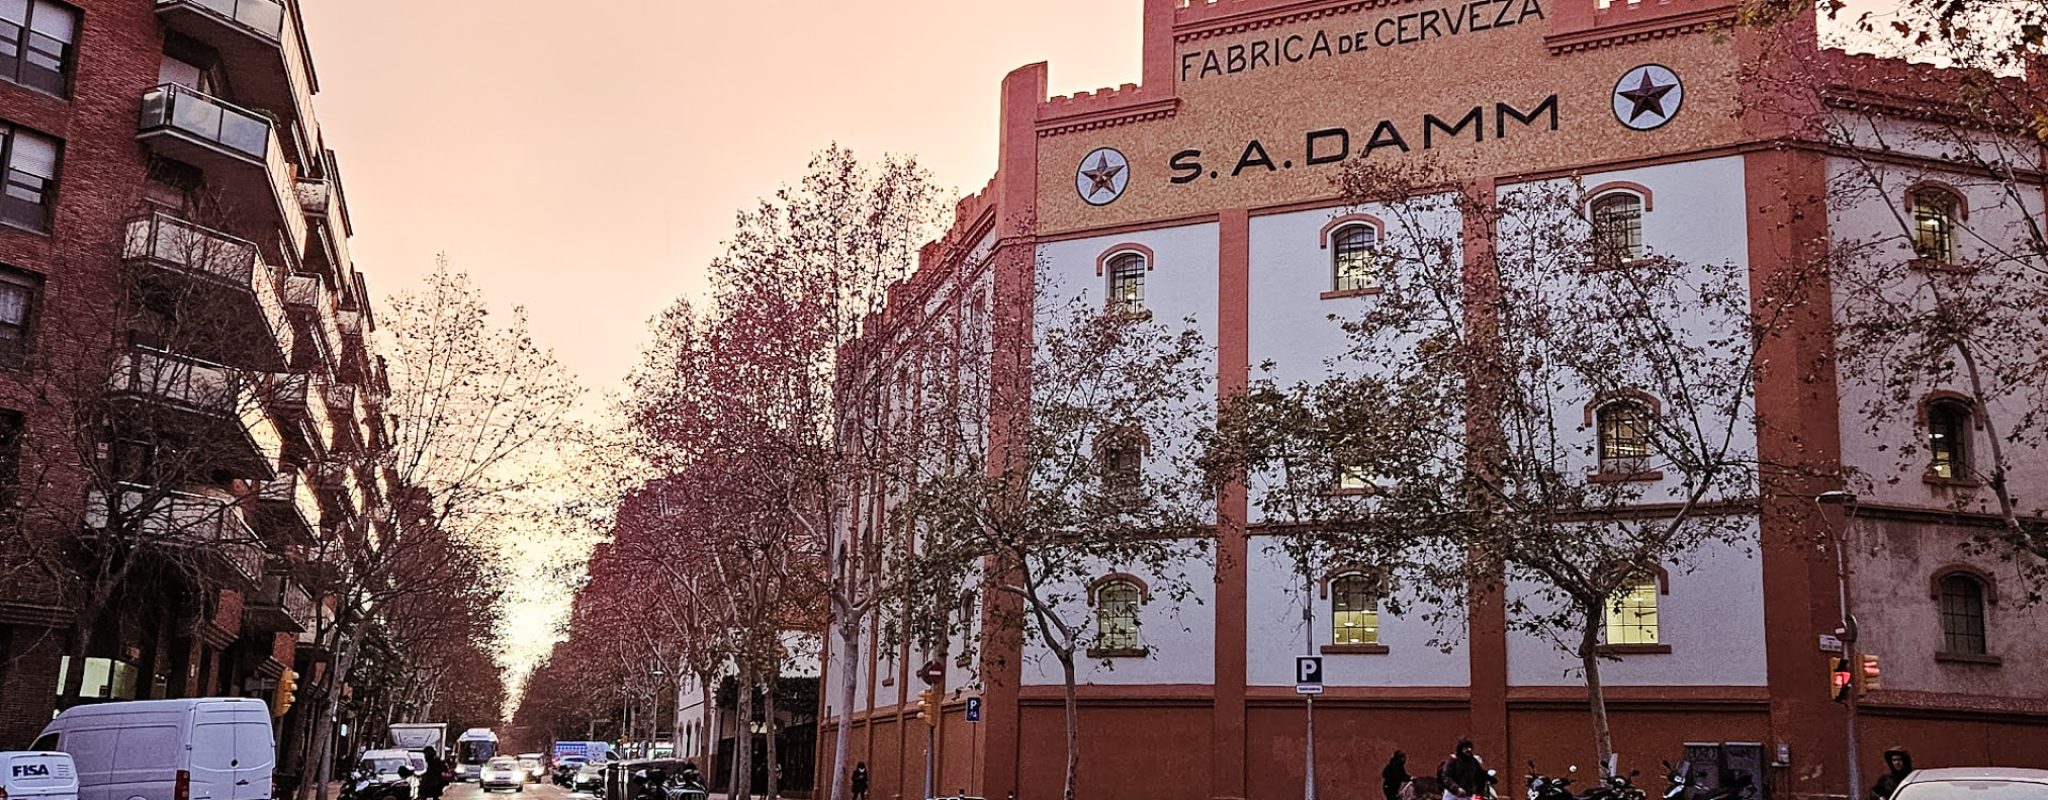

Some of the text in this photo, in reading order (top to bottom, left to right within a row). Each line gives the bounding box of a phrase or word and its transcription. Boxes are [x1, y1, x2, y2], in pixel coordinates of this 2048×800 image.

[1181, 0, 1545, 82] FABRICA DE CERVEZA
[1301, 659, 1317, 681] P
[12, 764, 49, 777] FISA
